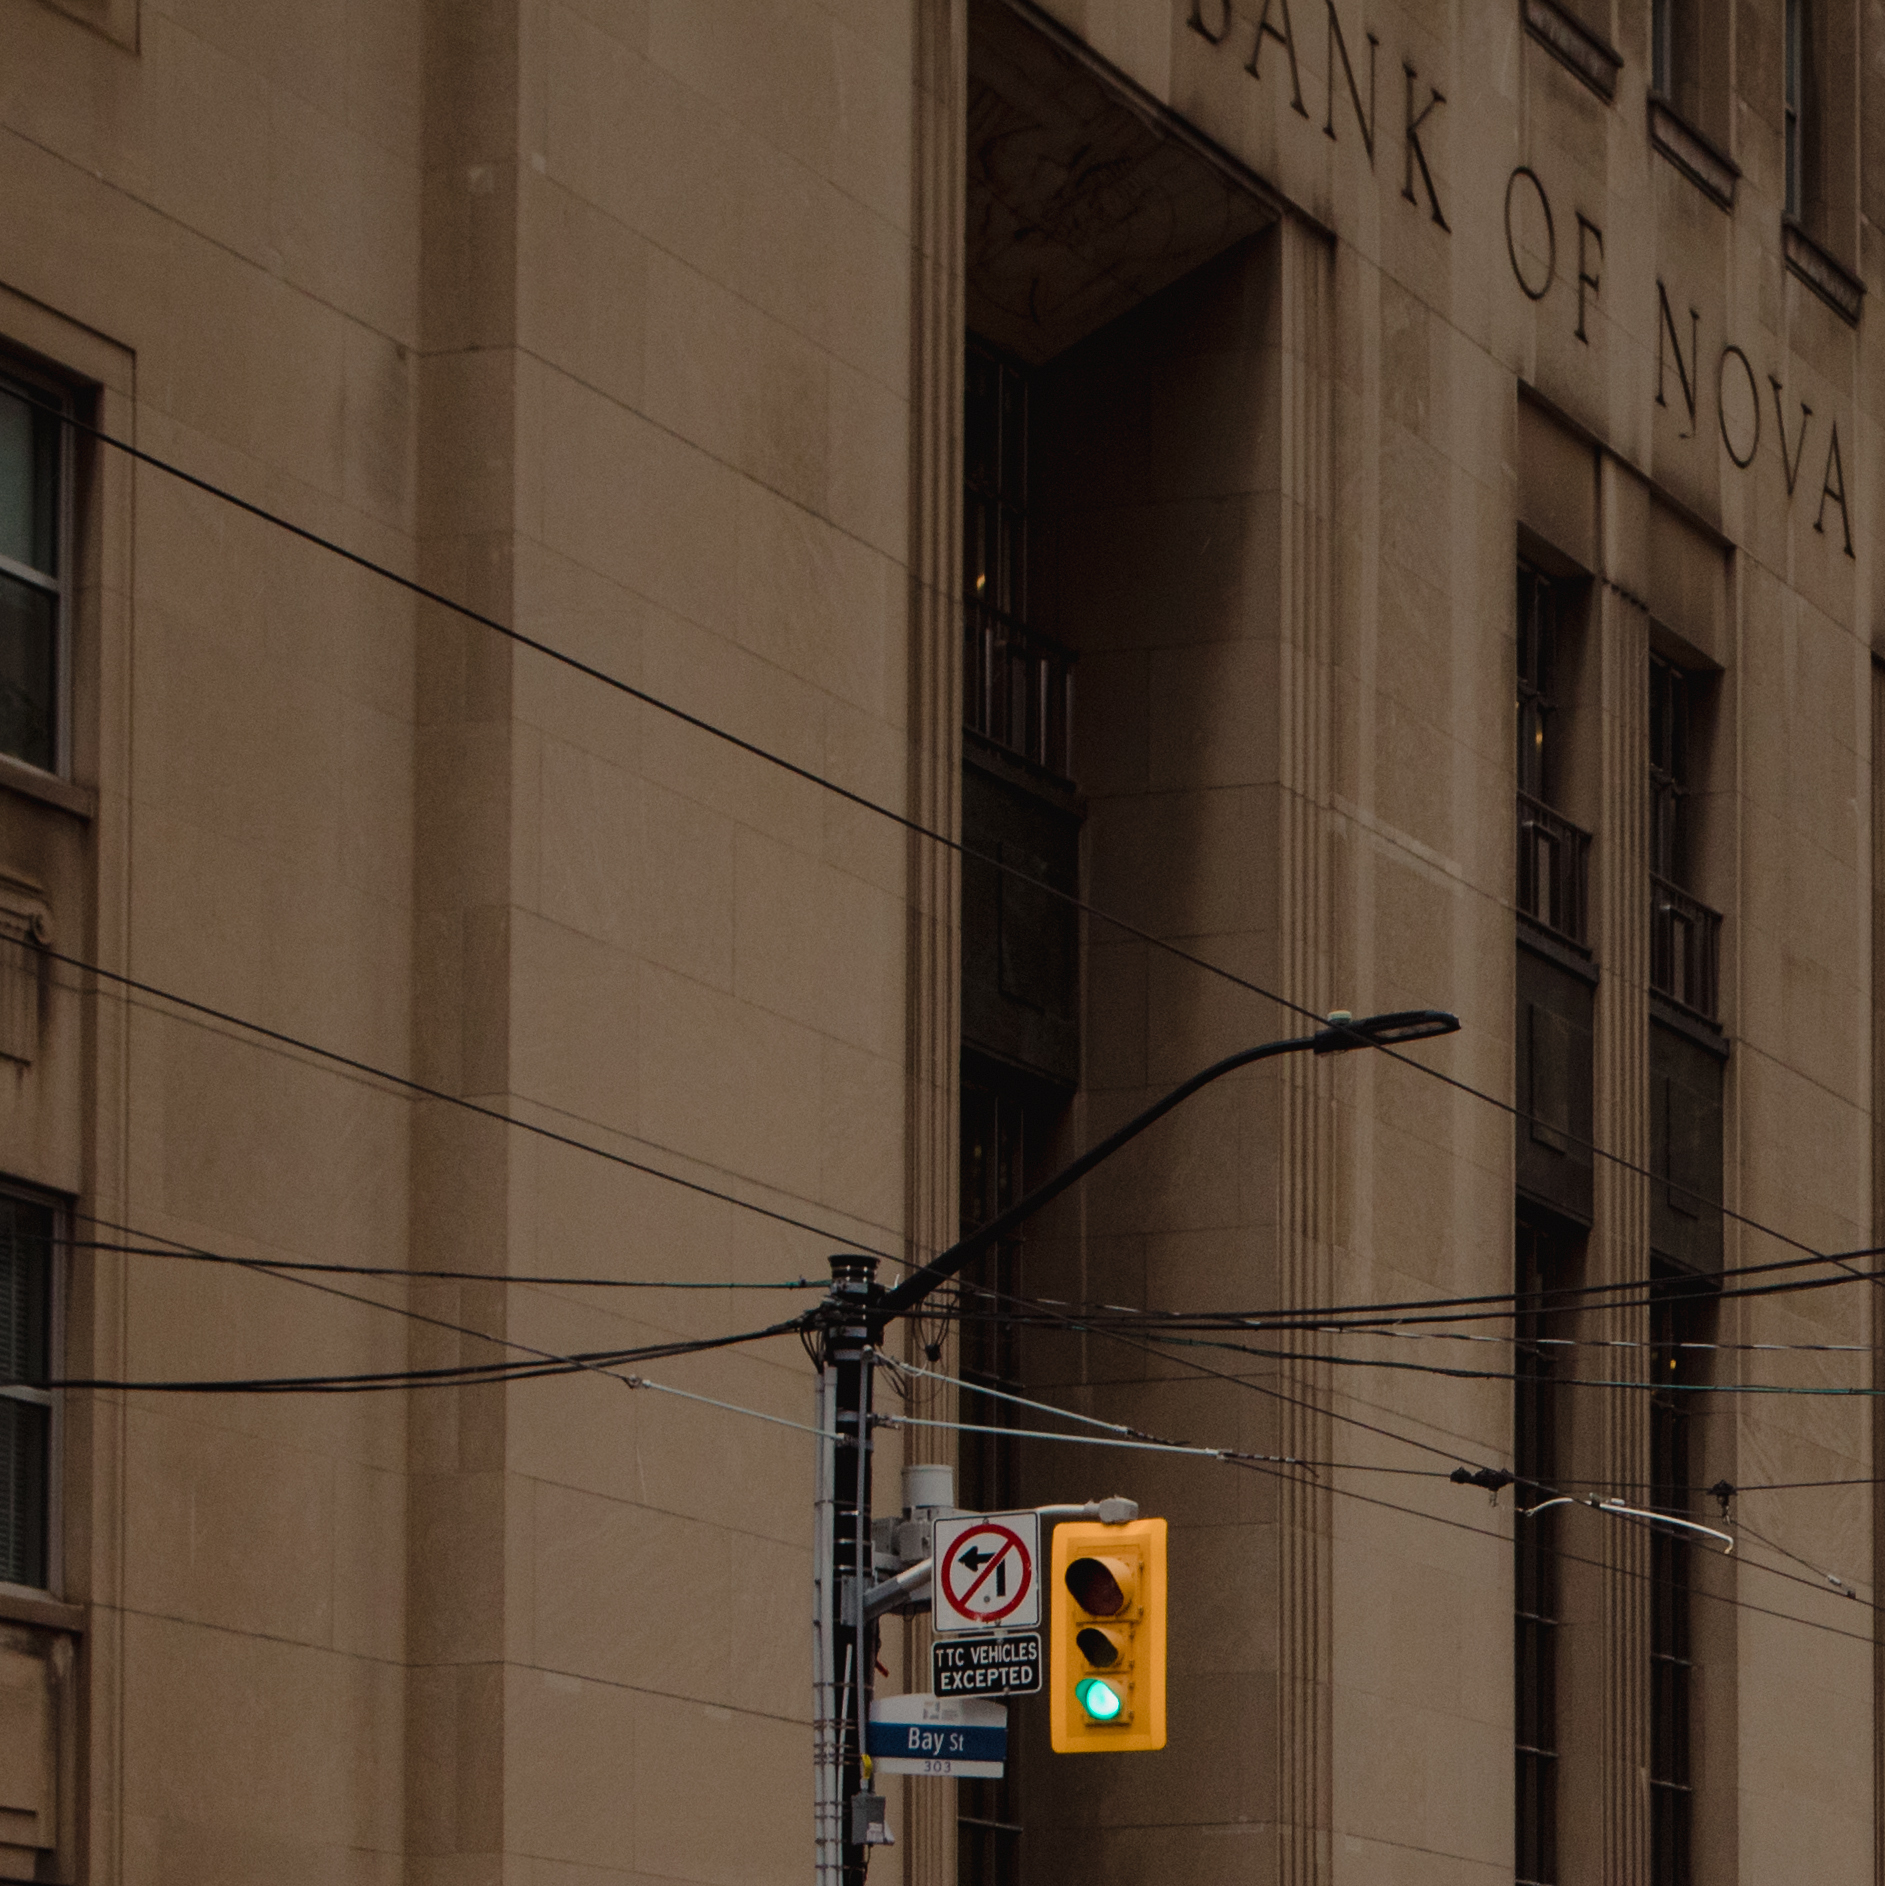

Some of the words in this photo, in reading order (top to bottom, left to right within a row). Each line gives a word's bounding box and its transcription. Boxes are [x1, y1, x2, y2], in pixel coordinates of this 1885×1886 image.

[1187, 0, 1452, 235] ANK
[1503, 165, 1605, 345] OF
[1655, 279, 1857, 560] NOVA
[935, 1646, 964, 1668] TTC
[970, 1641, 1038, 1664] VEHICLES
[940, 1665, 1033, 1690] EXCEPTED
[908, 1726, 944, 1755] Bay
[949, 1731, 965, 1752] St
[923, 1760, 952, 1773] 303
